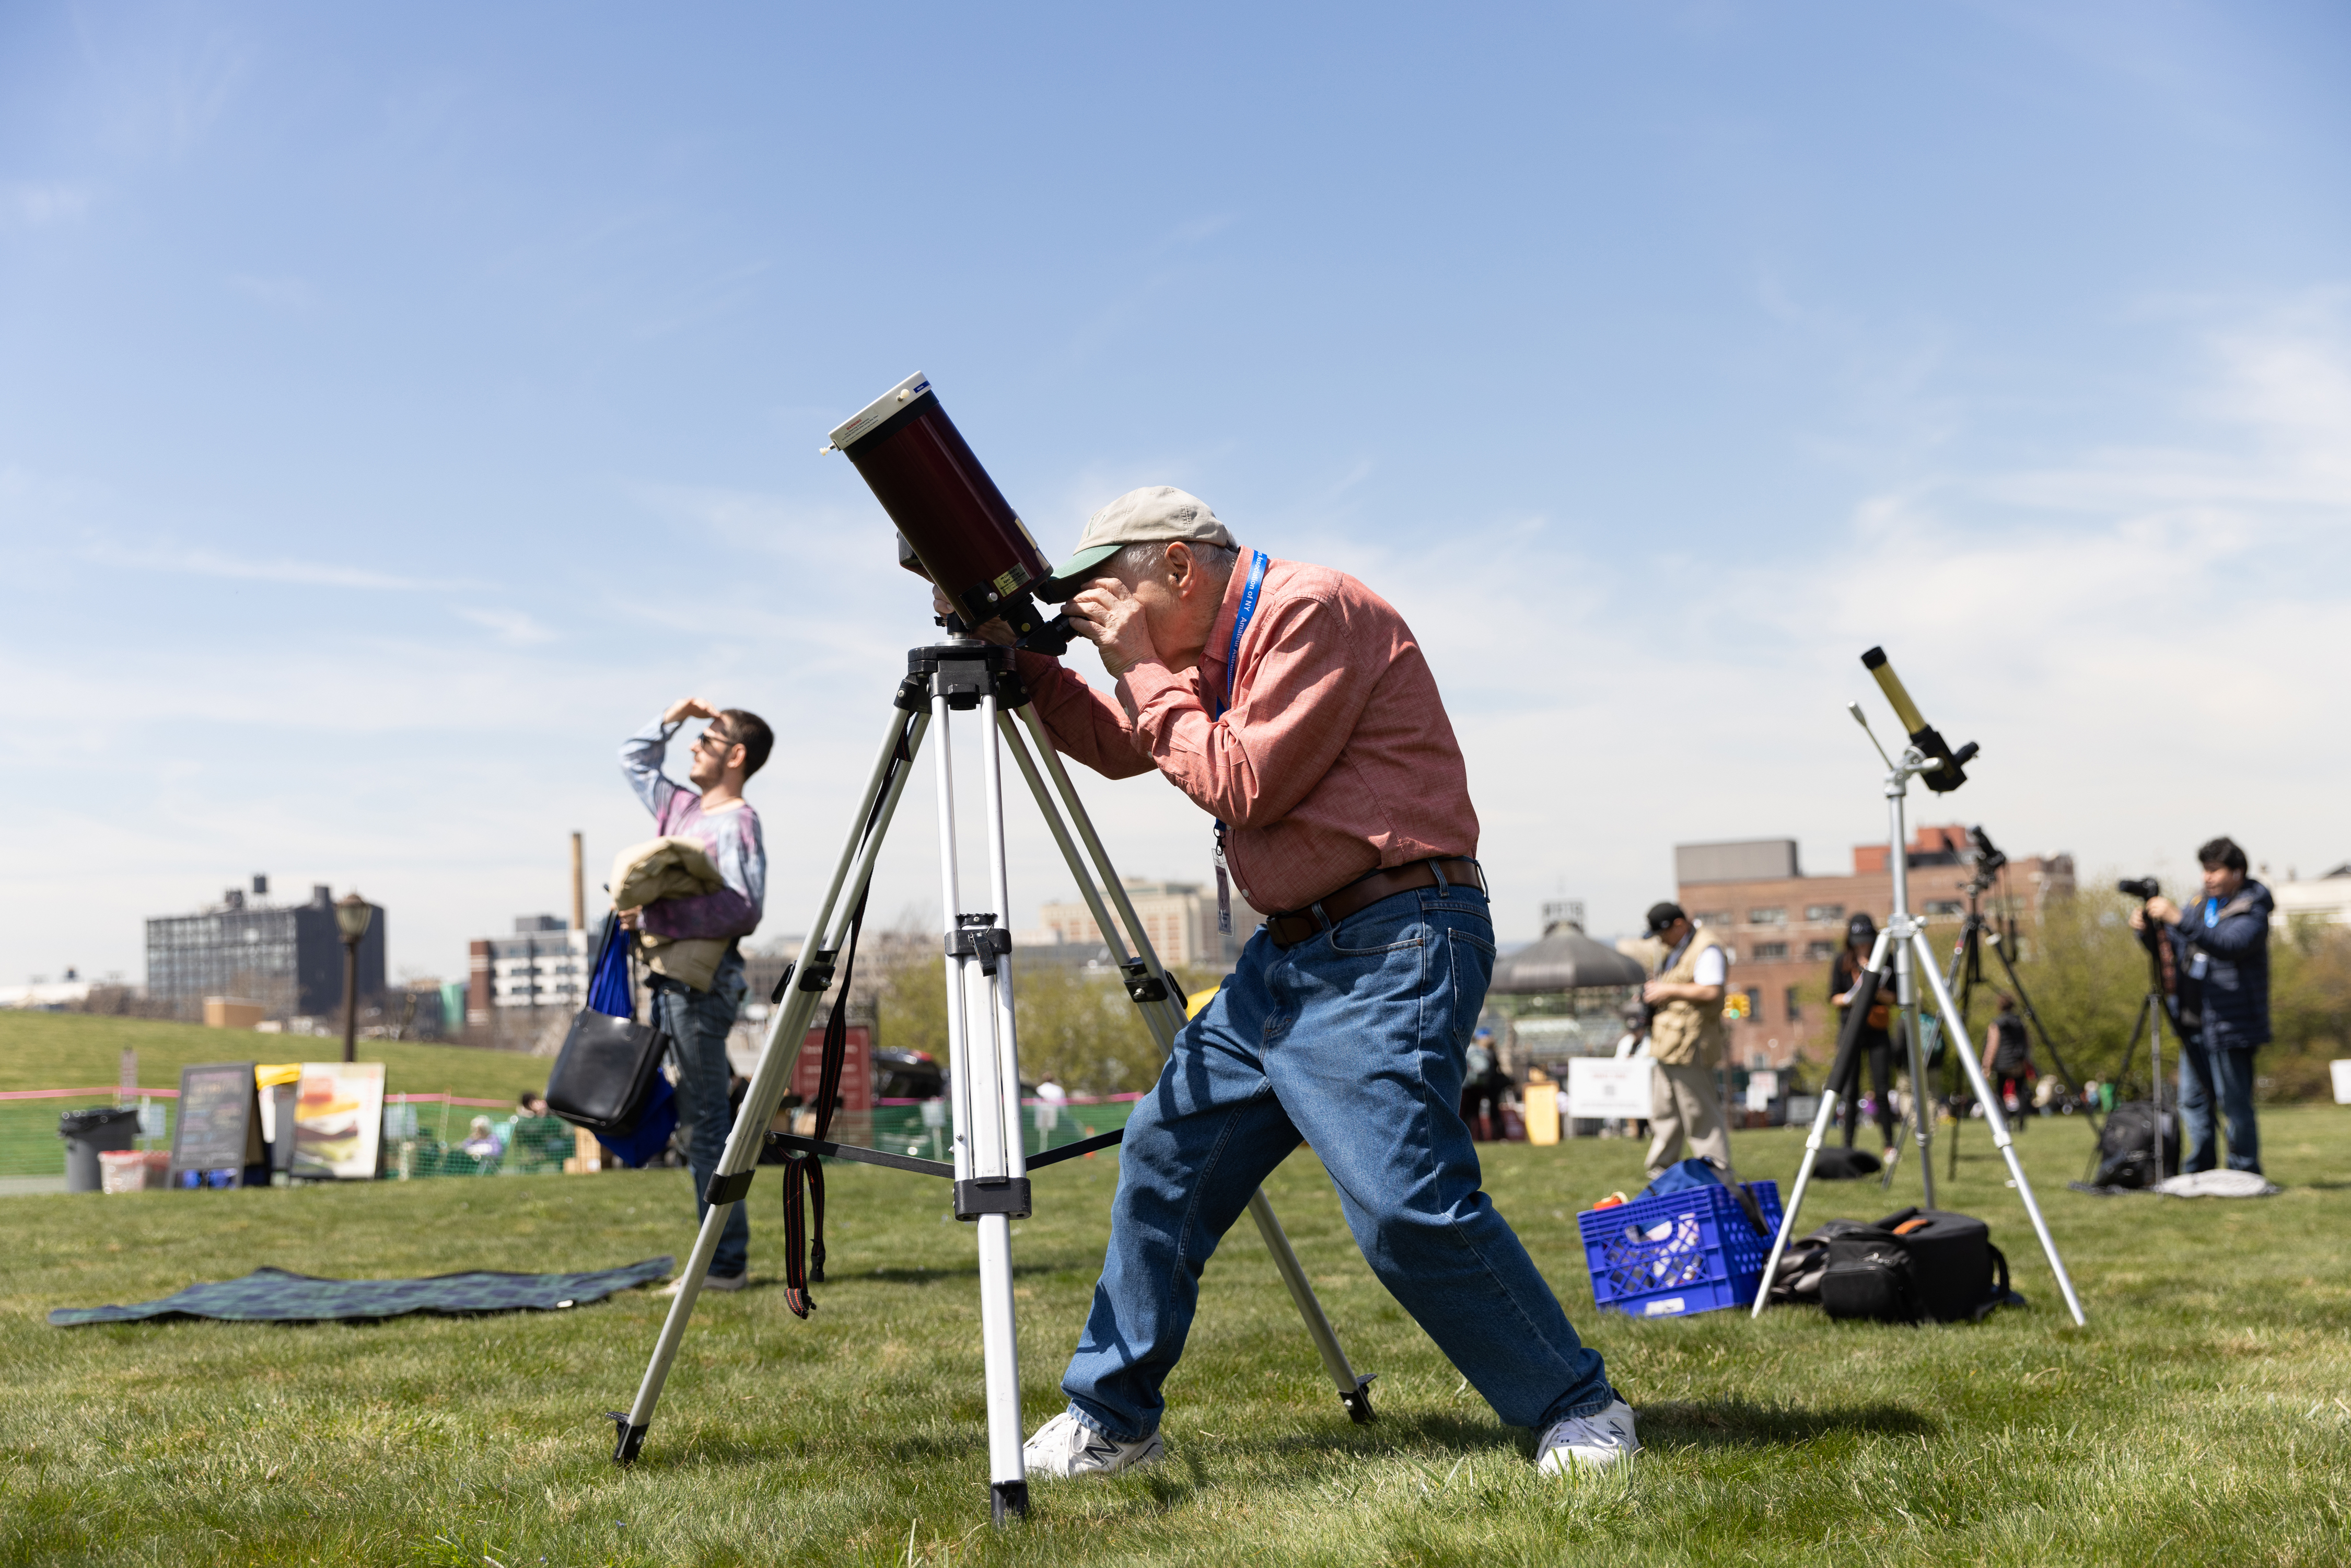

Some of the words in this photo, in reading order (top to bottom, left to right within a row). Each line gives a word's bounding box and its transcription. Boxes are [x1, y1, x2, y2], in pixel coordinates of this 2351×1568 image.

[846, 419, 862, 431] WARNING
[1004, 568, 1017, 578] ORION
[1249, 555, 1263, 589] Association
[1247, 591, 1253, 600] of
[1244, 600, 1252, 612] NY
[1235, 617, 1247, 648] Amateur
